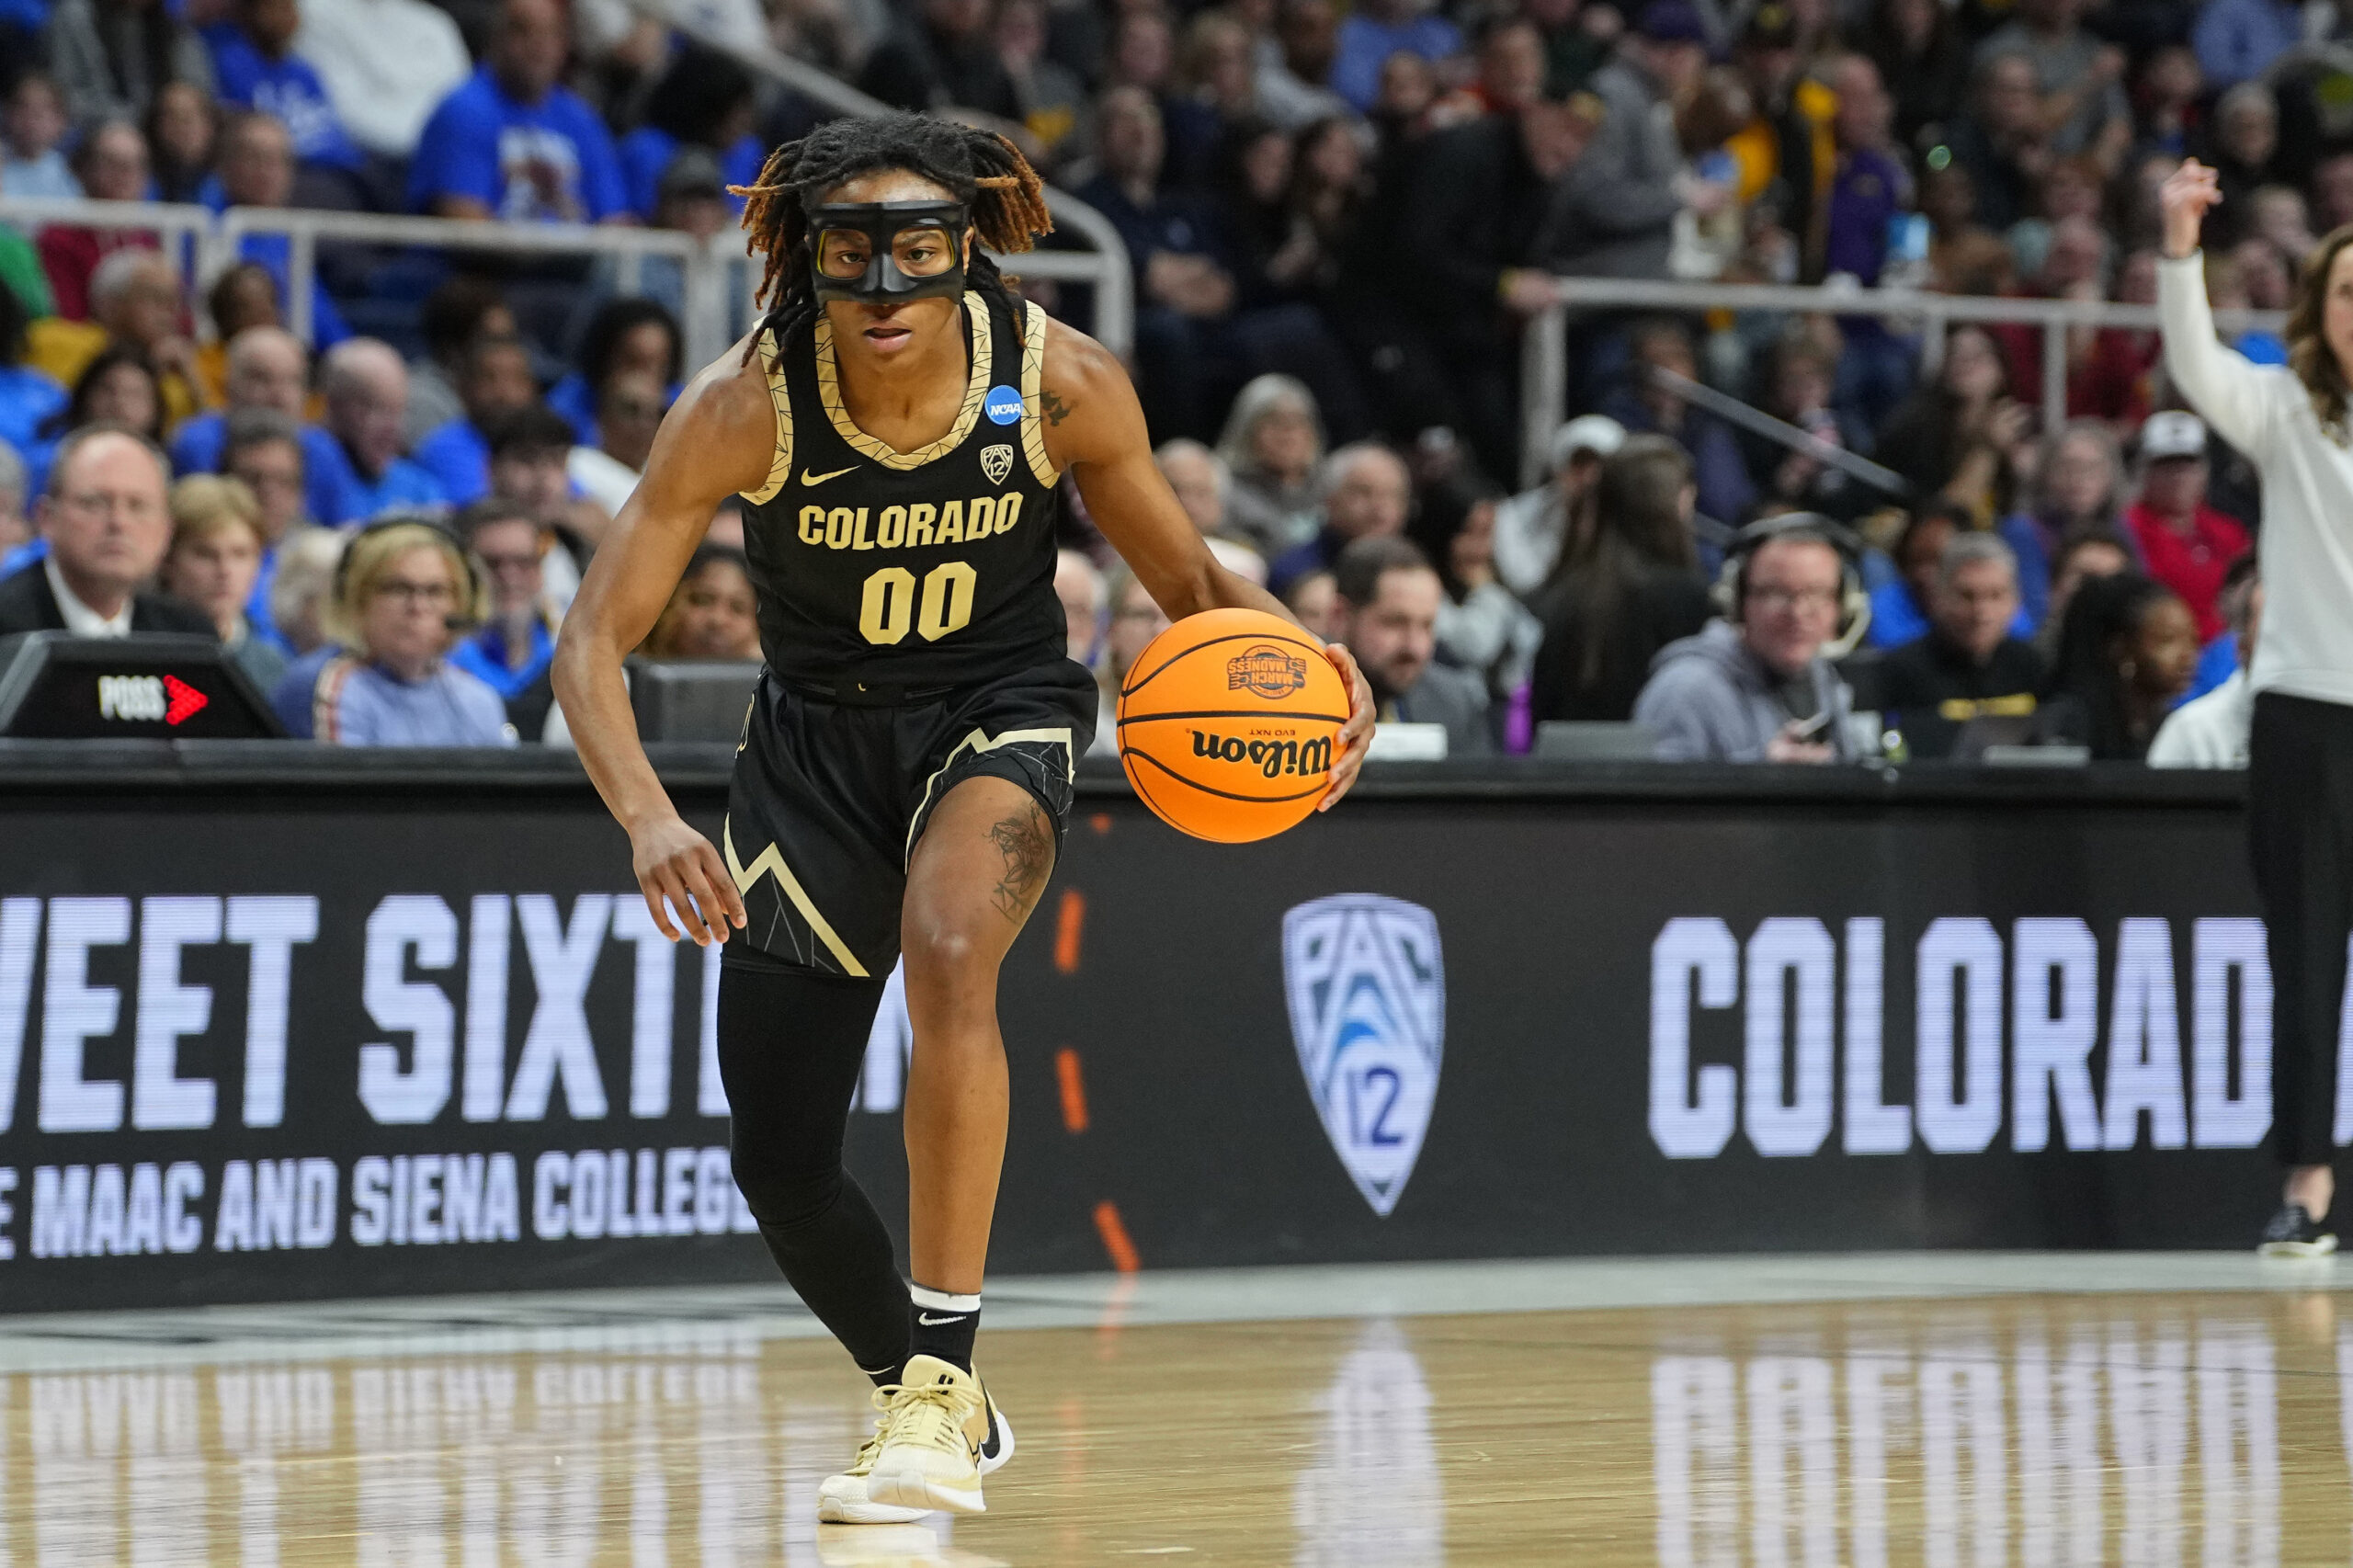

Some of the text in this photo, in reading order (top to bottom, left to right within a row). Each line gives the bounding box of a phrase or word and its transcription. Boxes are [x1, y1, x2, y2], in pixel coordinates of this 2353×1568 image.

[990, 403, 1022, 416] NCAA
[983, 446, 1011, 470] PAC
[990, 460, 1006, 476] 12
[797, 491, 1024, 551] COLORADO
[858, 561, 977, 645] 00
[1227, 659, 1288, 675] MADNESS
[1251, 672, 1294, 685] MARCH
[97, 676, 166, 721] POSS
[1192, 730, 1332, 778] Wilson
[1649, 916, 2353, 1158] COLORAD
[1344, 1066, 1404, 1148] 12
[30, 1161, 205, 1259] MAAC
[214, 1155, 339, 1252] AND
[350, 1152, 520, 1246] SIENA
